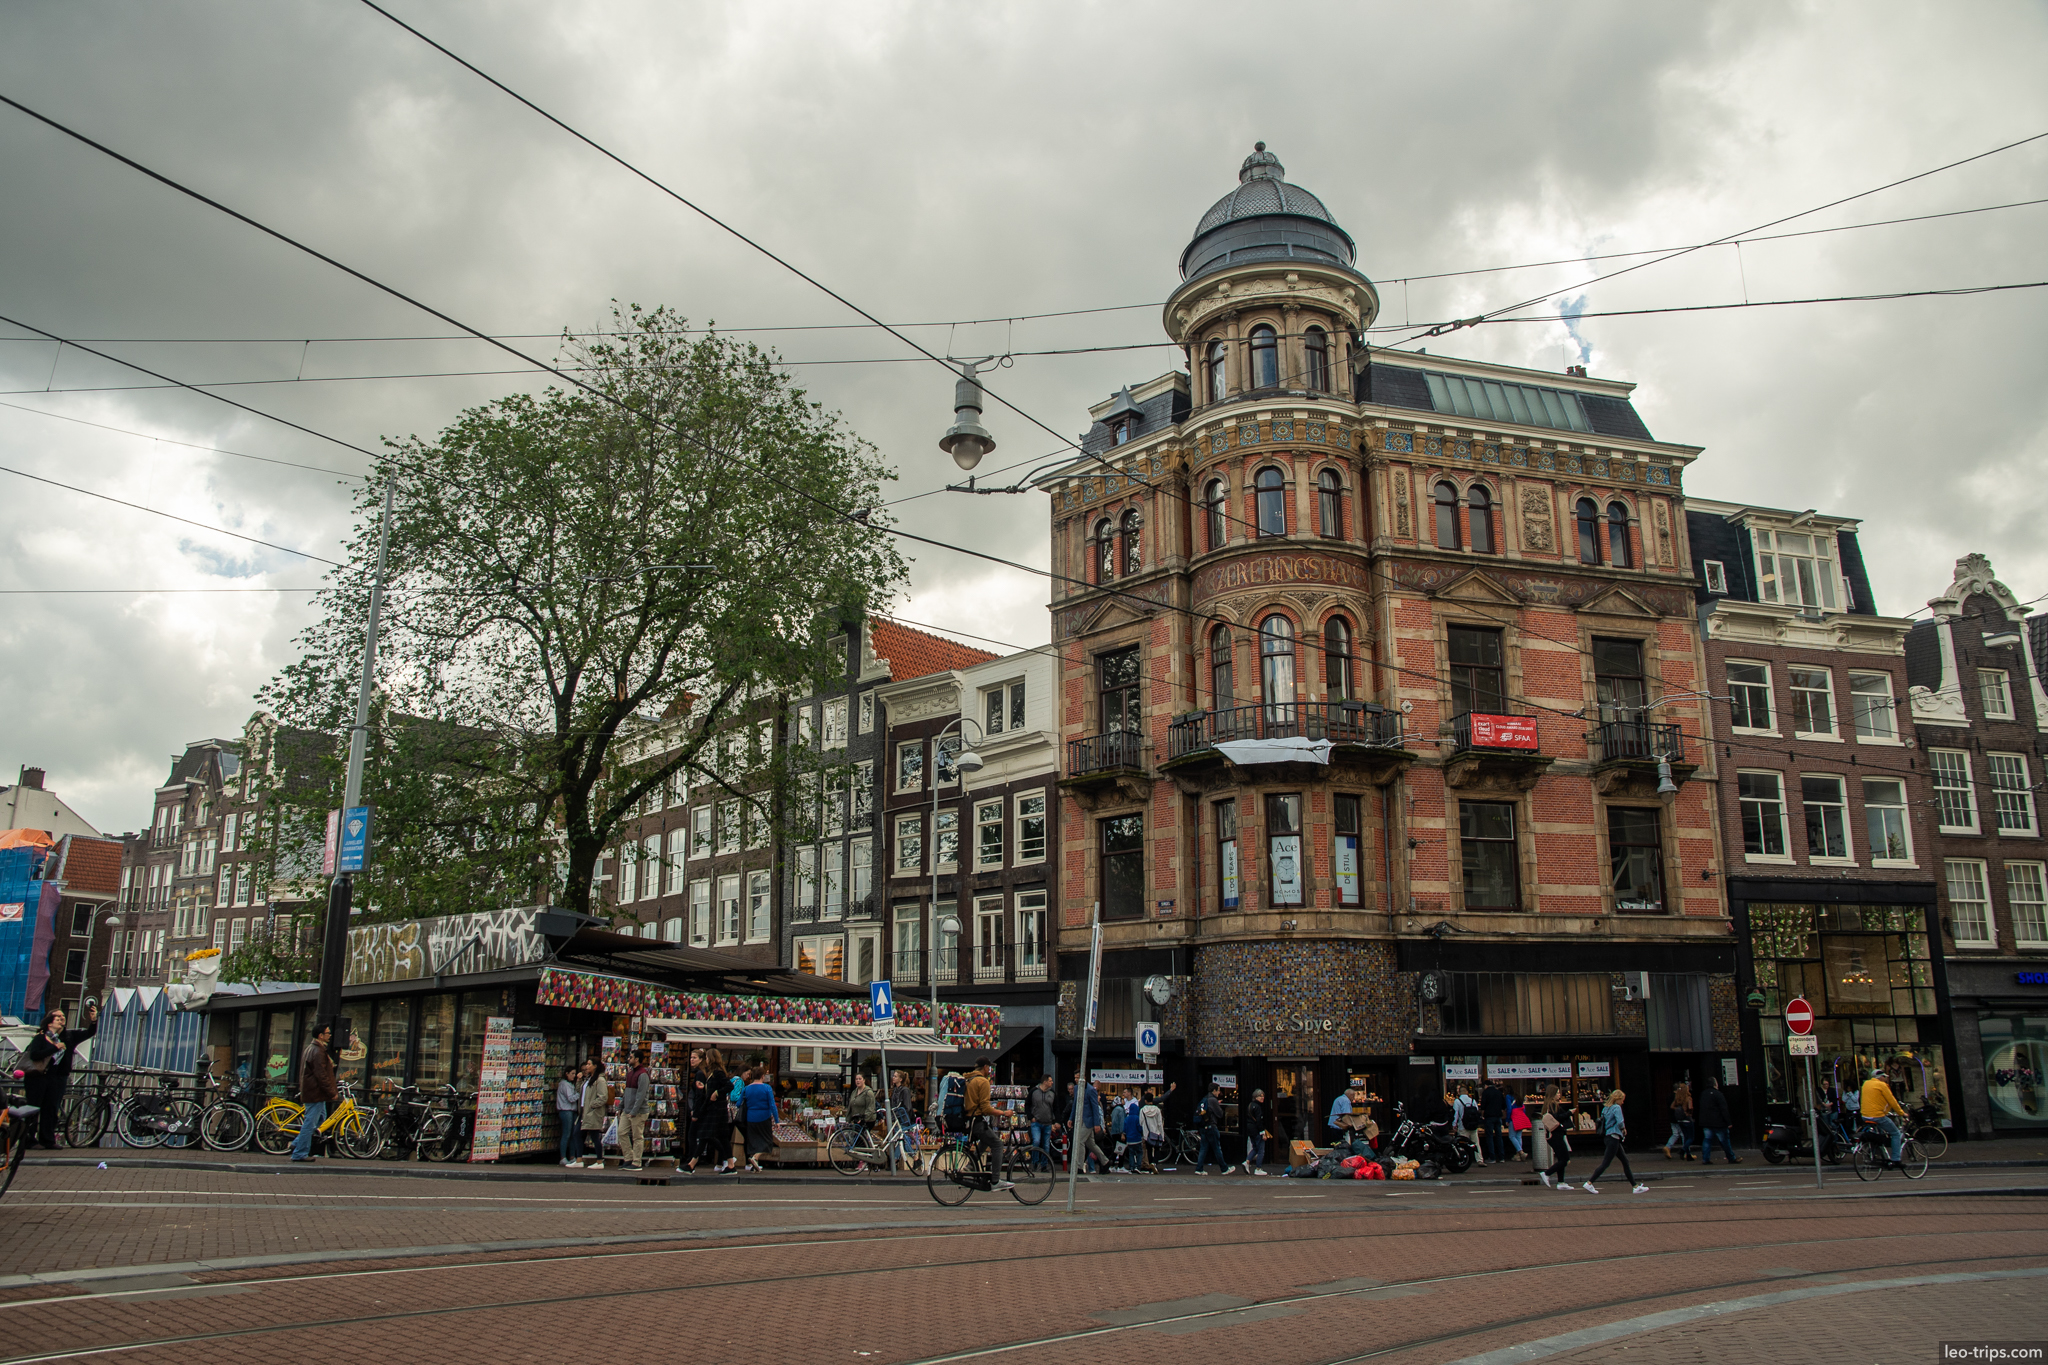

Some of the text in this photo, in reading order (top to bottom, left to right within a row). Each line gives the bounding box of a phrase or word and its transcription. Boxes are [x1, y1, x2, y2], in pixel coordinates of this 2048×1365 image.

[1275, 841, 1297, 853] Ace
[1344, 873, 1351, 884] DE
[1243, 1013, 1339, 1035] Ace & Spyer
[374, 1051, 400, 1069] need
[339, 1068, 358, 1080] you
